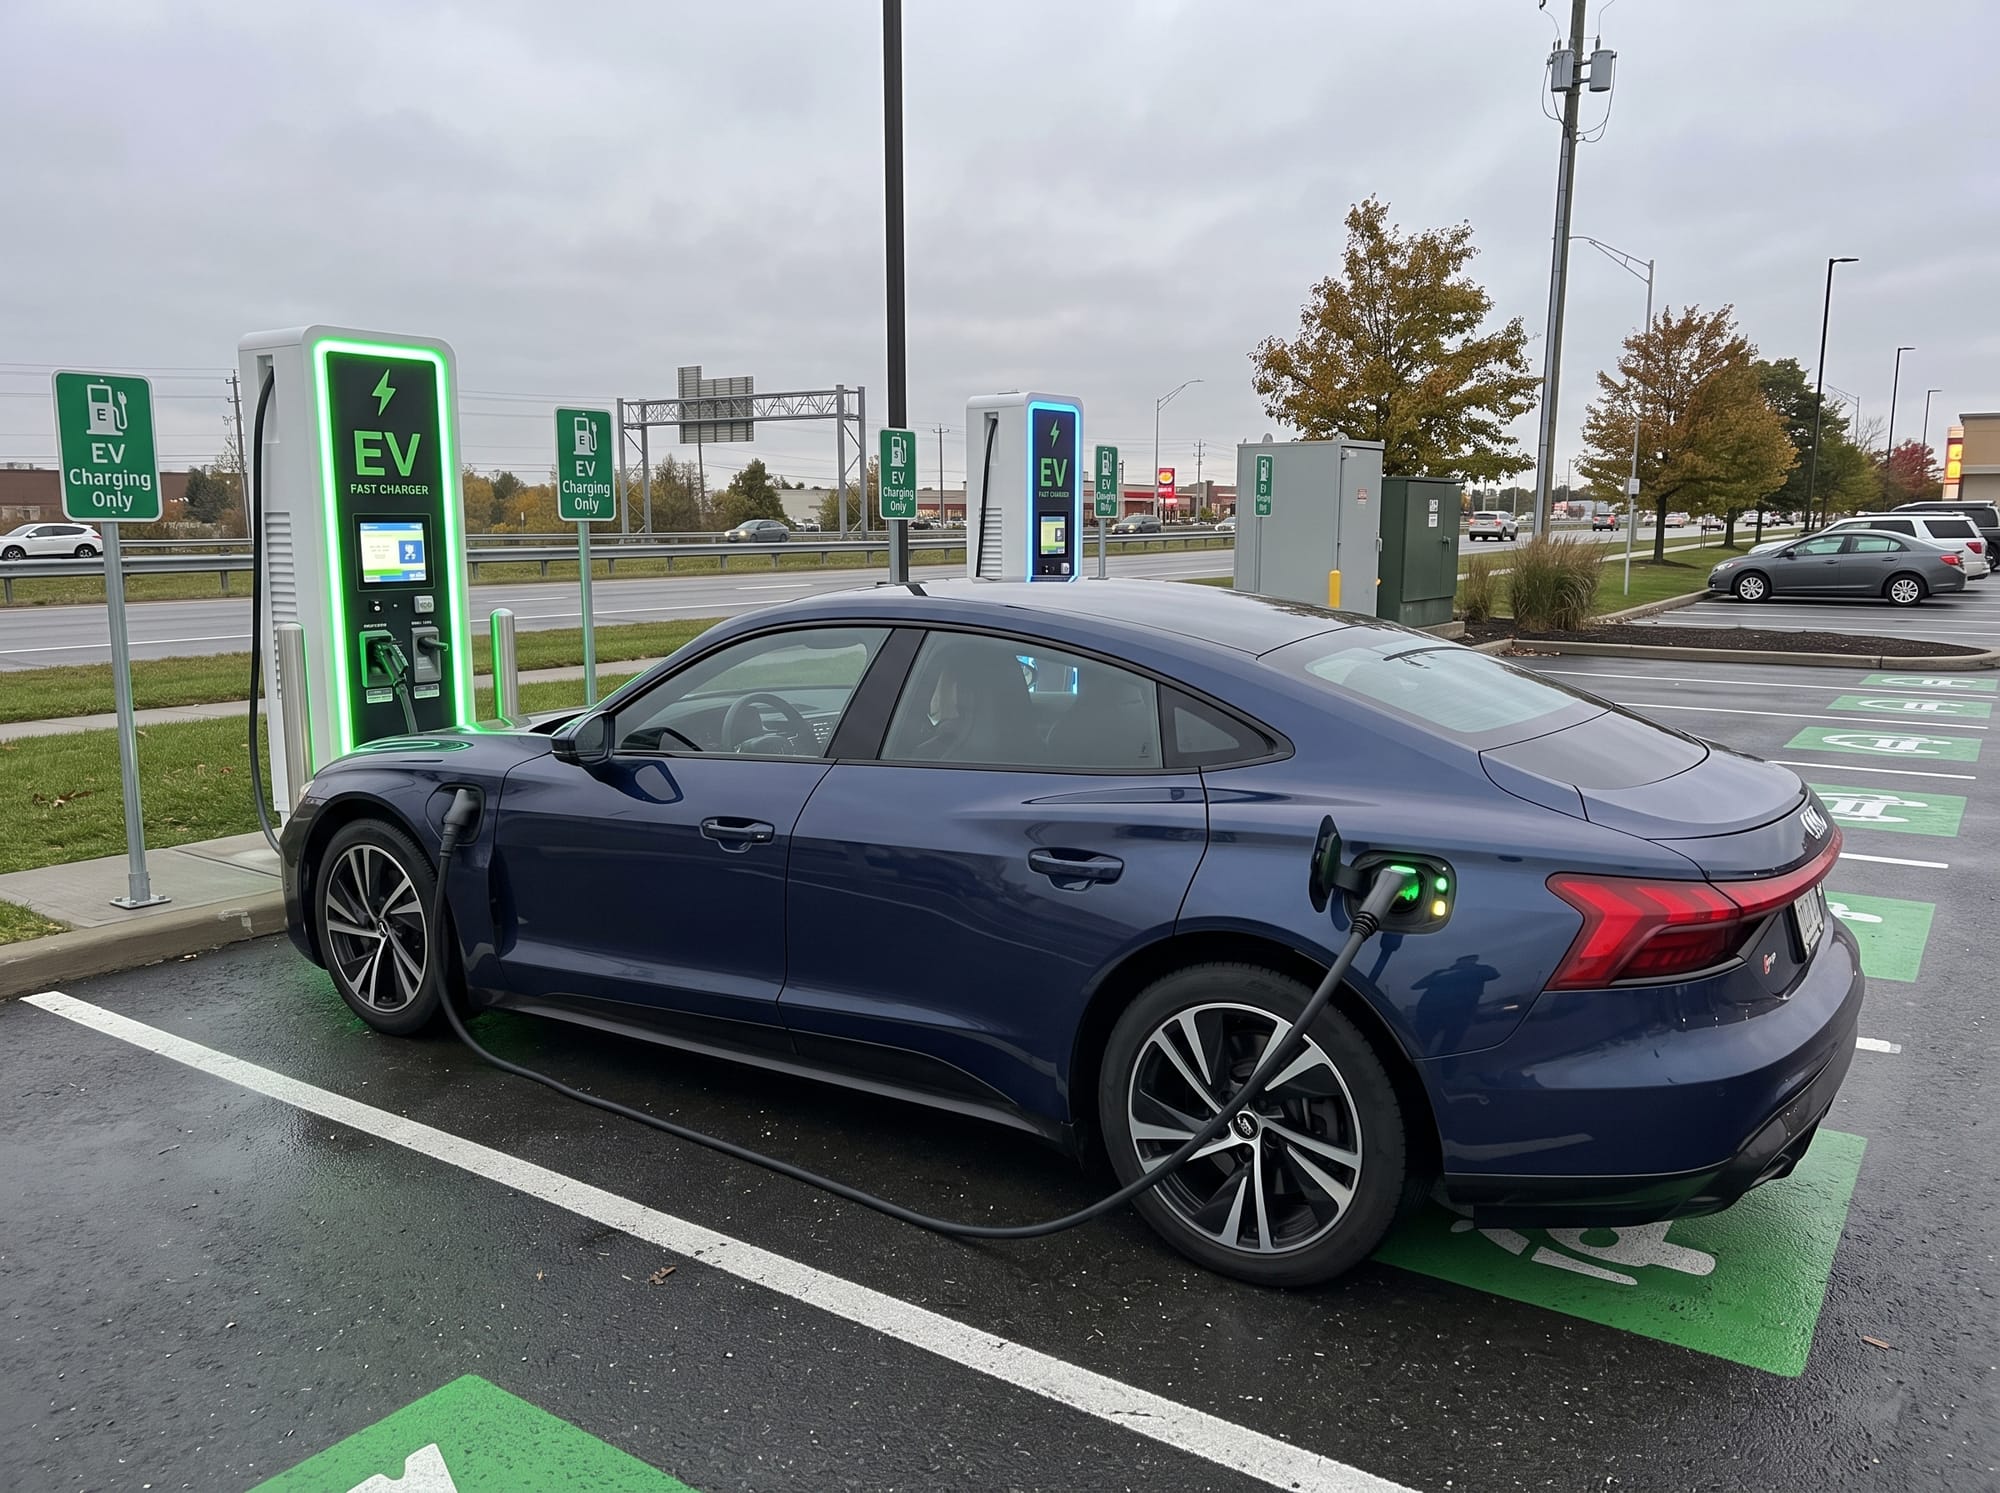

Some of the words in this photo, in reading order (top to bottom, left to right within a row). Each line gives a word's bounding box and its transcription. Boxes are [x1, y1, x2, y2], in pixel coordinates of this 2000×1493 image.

[97, 408, 107, 421] E
[579, 435, 586, 445] E
[91, 443, 125, 463] EV
[354, 430, 420, 476] EV
[576, 460, 595, 476] EV
[1040, 458, 1068, 487] EV
[69, 468, 151, 491] Charging
[891, 471, 905, 484] EV
[1102, 479, 1111, 490] EV
[350, 484, 377, 494] FAST
[380, 484, 429, 495] CHARGER
[562, 480, 610, 497] Charging
[883, 486, 914, 500] Charging
[92, 491, 133, 512] Only
[574, 497, 599, 514] Only
[890, 500, 906, 513] Only
